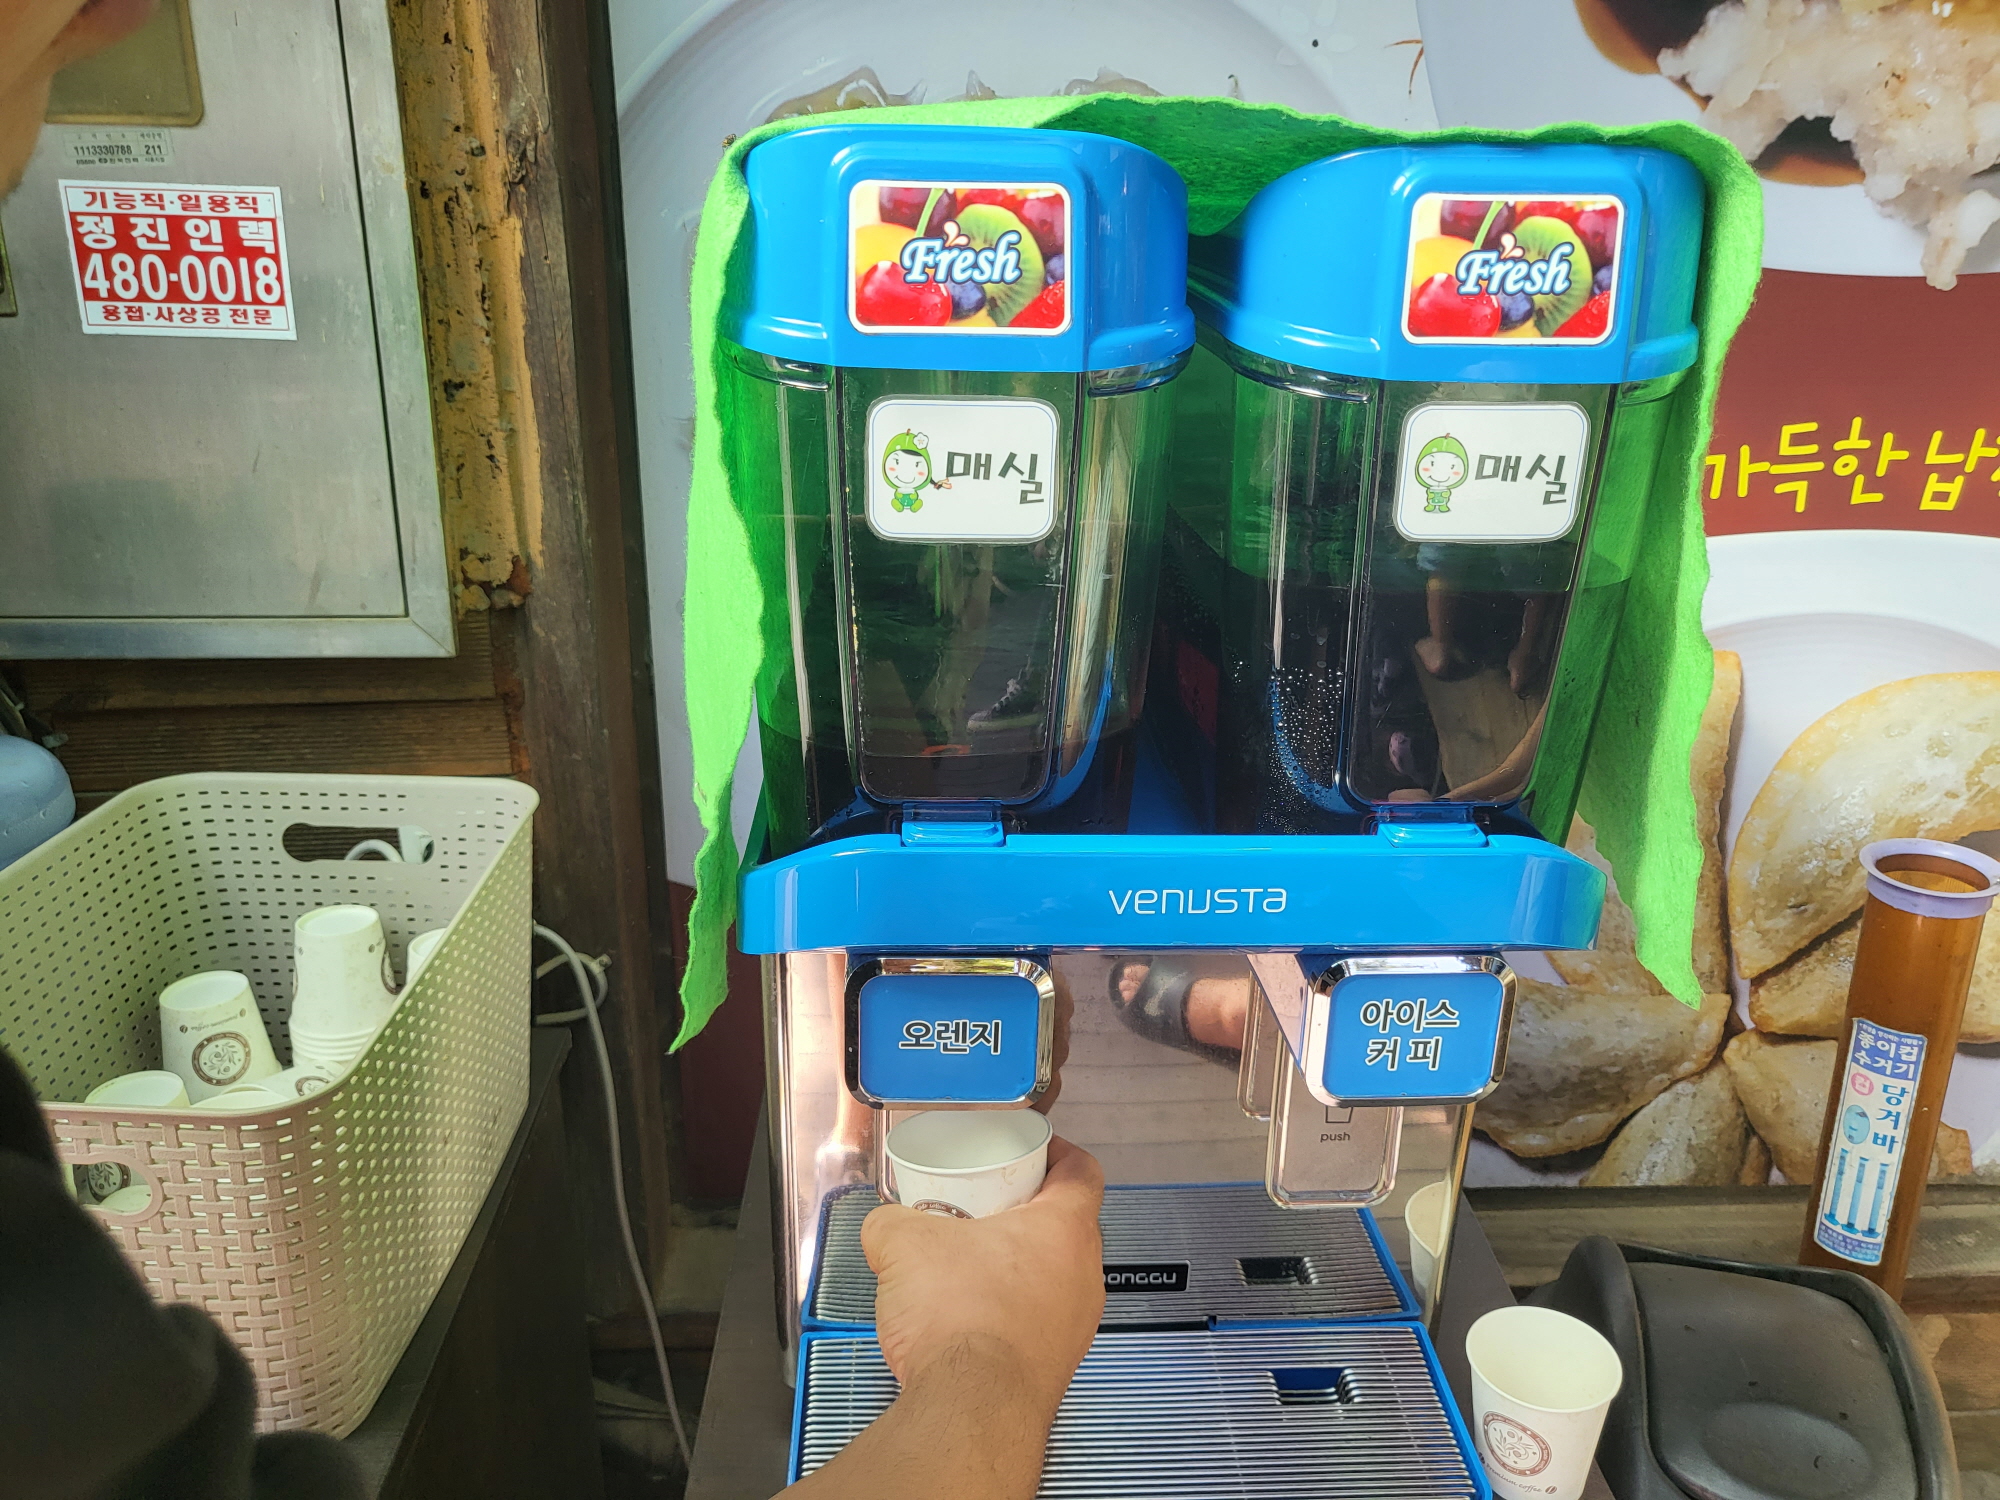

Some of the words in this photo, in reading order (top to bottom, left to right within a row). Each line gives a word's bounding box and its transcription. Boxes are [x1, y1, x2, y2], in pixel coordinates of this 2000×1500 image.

[74, 144, 133, 156] 1113330788
[144, 144, 163, 156] 211
[900, 230, 1022, 284] Fresh
[1456, 242, 1575, 296] Fresh
[84, 252, 282, 304] 480-0018
[229, 308, 272, 326] 전문
[945, 451, 1045, 505] 매실
[1474, 453, 1568, 506] 매실
[1918, 427, 2000, 511] 납
[1360, 998, 1460, 1034] 아이스
[898, 1019, 1003, 1055] 오렌지
[1364, 1036, 1443, 1072] 커피
[1858, 1030, 1919, 1062] 종이컵
[1854, 1049, 1915, 1079] 수거기
[1320, 1131, 1351, 1143] push
[1518, 1483, 1543, 1493] coffee
